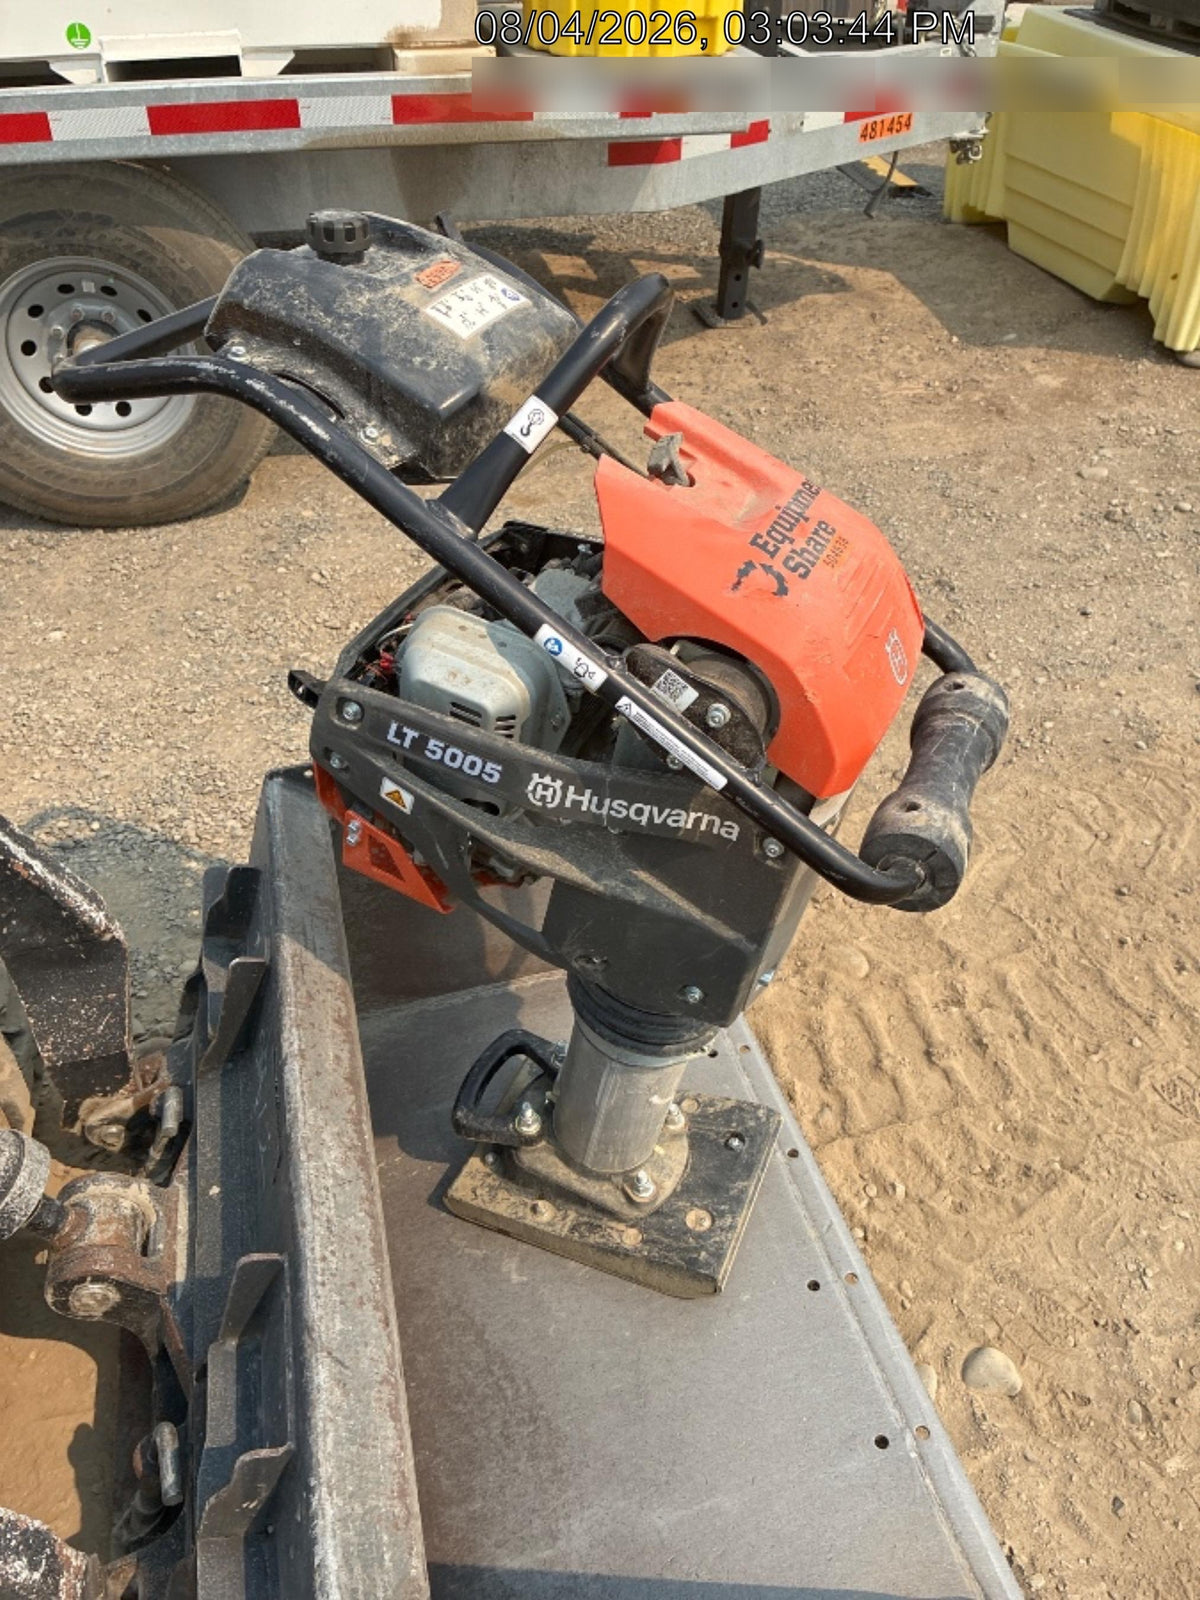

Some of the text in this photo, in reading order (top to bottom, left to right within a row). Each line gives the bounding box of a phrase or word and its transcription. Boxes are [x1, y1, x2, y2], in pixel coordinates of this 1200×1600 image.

[860, 112, 912, 141] 481454
[749, 479, 821, 560] Equipme
[782, 520, 836, 580] Share
[386, 720, 502, 784] LT 5005
[564, 785, 741, 842] Husqvarna
